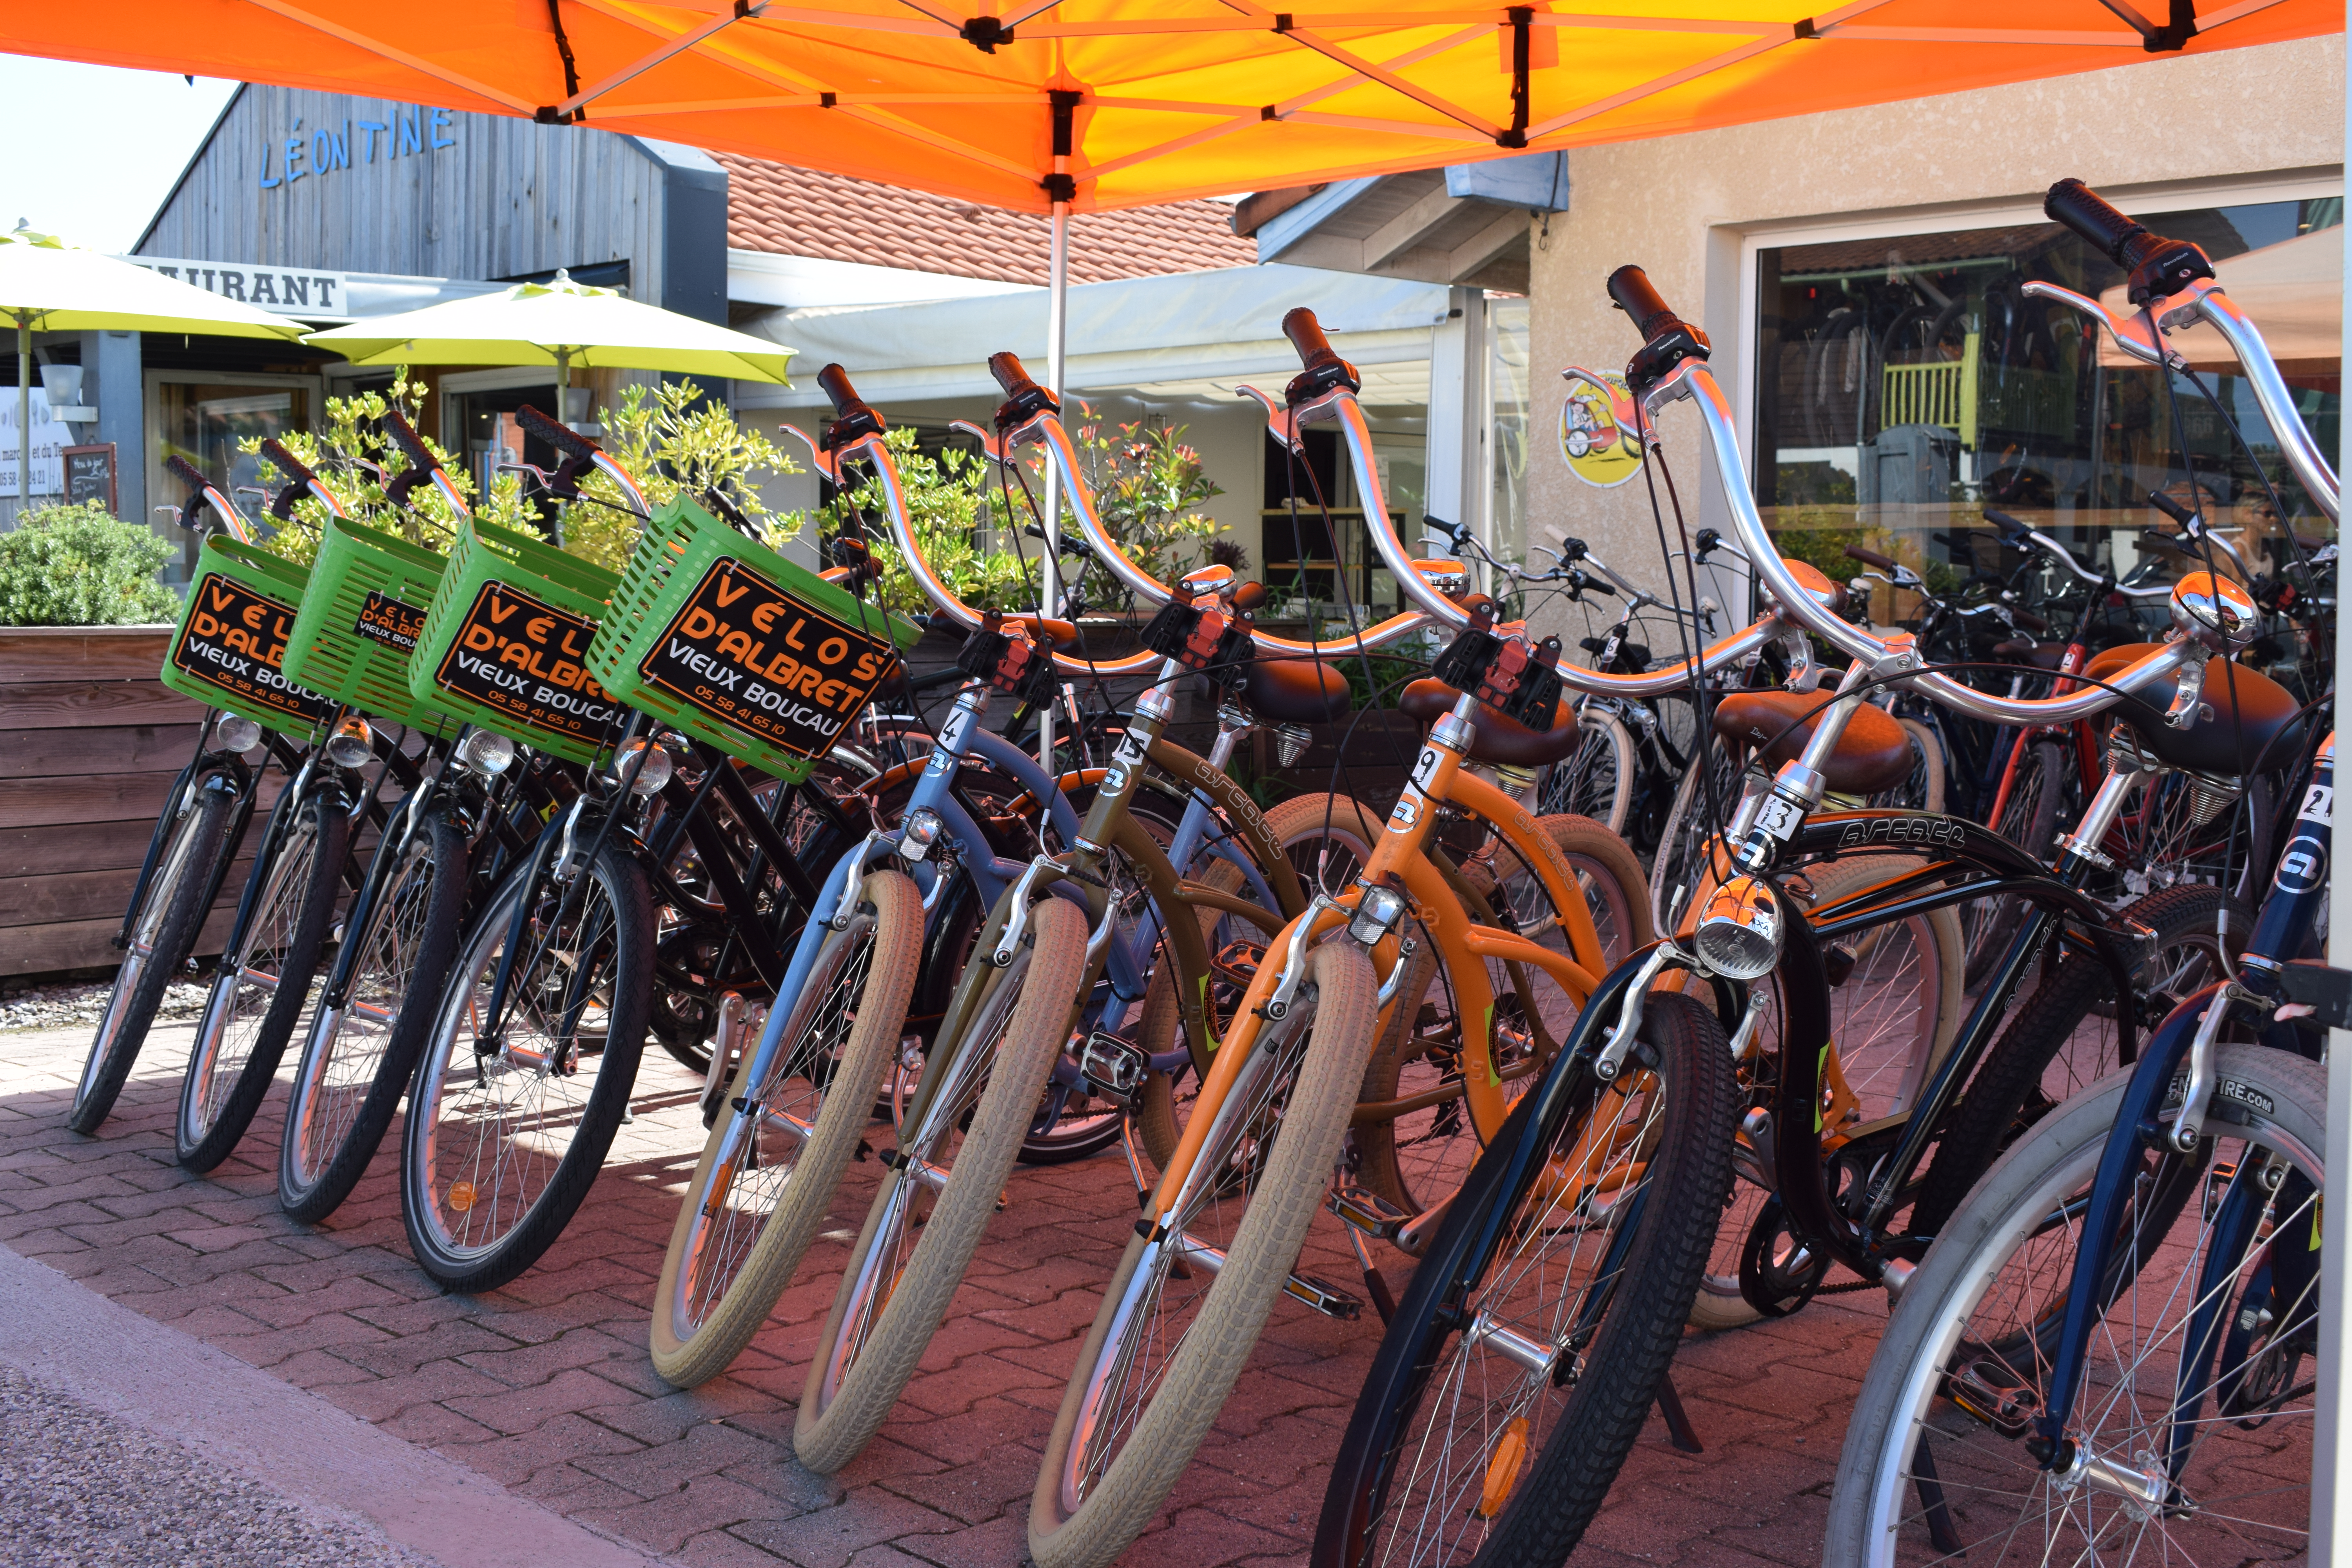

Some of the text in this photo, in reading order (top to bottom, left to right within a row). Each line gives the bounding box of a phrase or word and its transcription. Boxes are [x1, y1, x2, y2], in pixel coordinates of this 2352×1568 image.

[260, 105, 455, 188] LÉONTINE
[2163, 252, 2189, 267] RevoShift
[134, 265, 336, 307] URANT
[1658, 334, 1681, 352] RevoShift
[1318, 367, 1339, 377] RevoShift
[1019, 392, 1036, 403] RevoShift
[851, 415, 869, 424] RevoShift
[33, 446, 40, 458] et
[42, 443, 51, 458] du
[9, 472, 16, 486] 58
[38, 470, 45, 485] 21
[212, 586, 291, 641] VÉL
[360, 621, 390, 639] VIEUX
[361, 610, 421, 639] D'ALBR
[370, 599, 426, 628] VÉLO
[490, 597, 581, 657] VÉL
[717, 574, 886, 681] VÉLOS
[189, 636, 251, 676] VIEUX
[193, 611, 289, 668] D'ALB
[1608, 638, 1617, 652] 6
[457, 650, 530, 695] VIEUX
[681, 608, 867, 713] D'ALBRET
[218, 672, 299, 708] 05 58 41 65 10
[669, 637, 841, 737] VIEUX BOUCAU
[488, 690, 581, 730] 05 58 41 65 10
[695, 685, 786, 735] 05 58 41 65 10
[943, 711, 963, 741] 4
[1414, 750, 1436, 783] 9
[1195, 760, 1282, 860] arcade
[1760, 798, 1793, 832] 13
[1837, 815, 1965, 849] arcade
[1514, 810, 1575, 891] arcade
[1207, 1021, 1216, 1040] SOUSTONS
